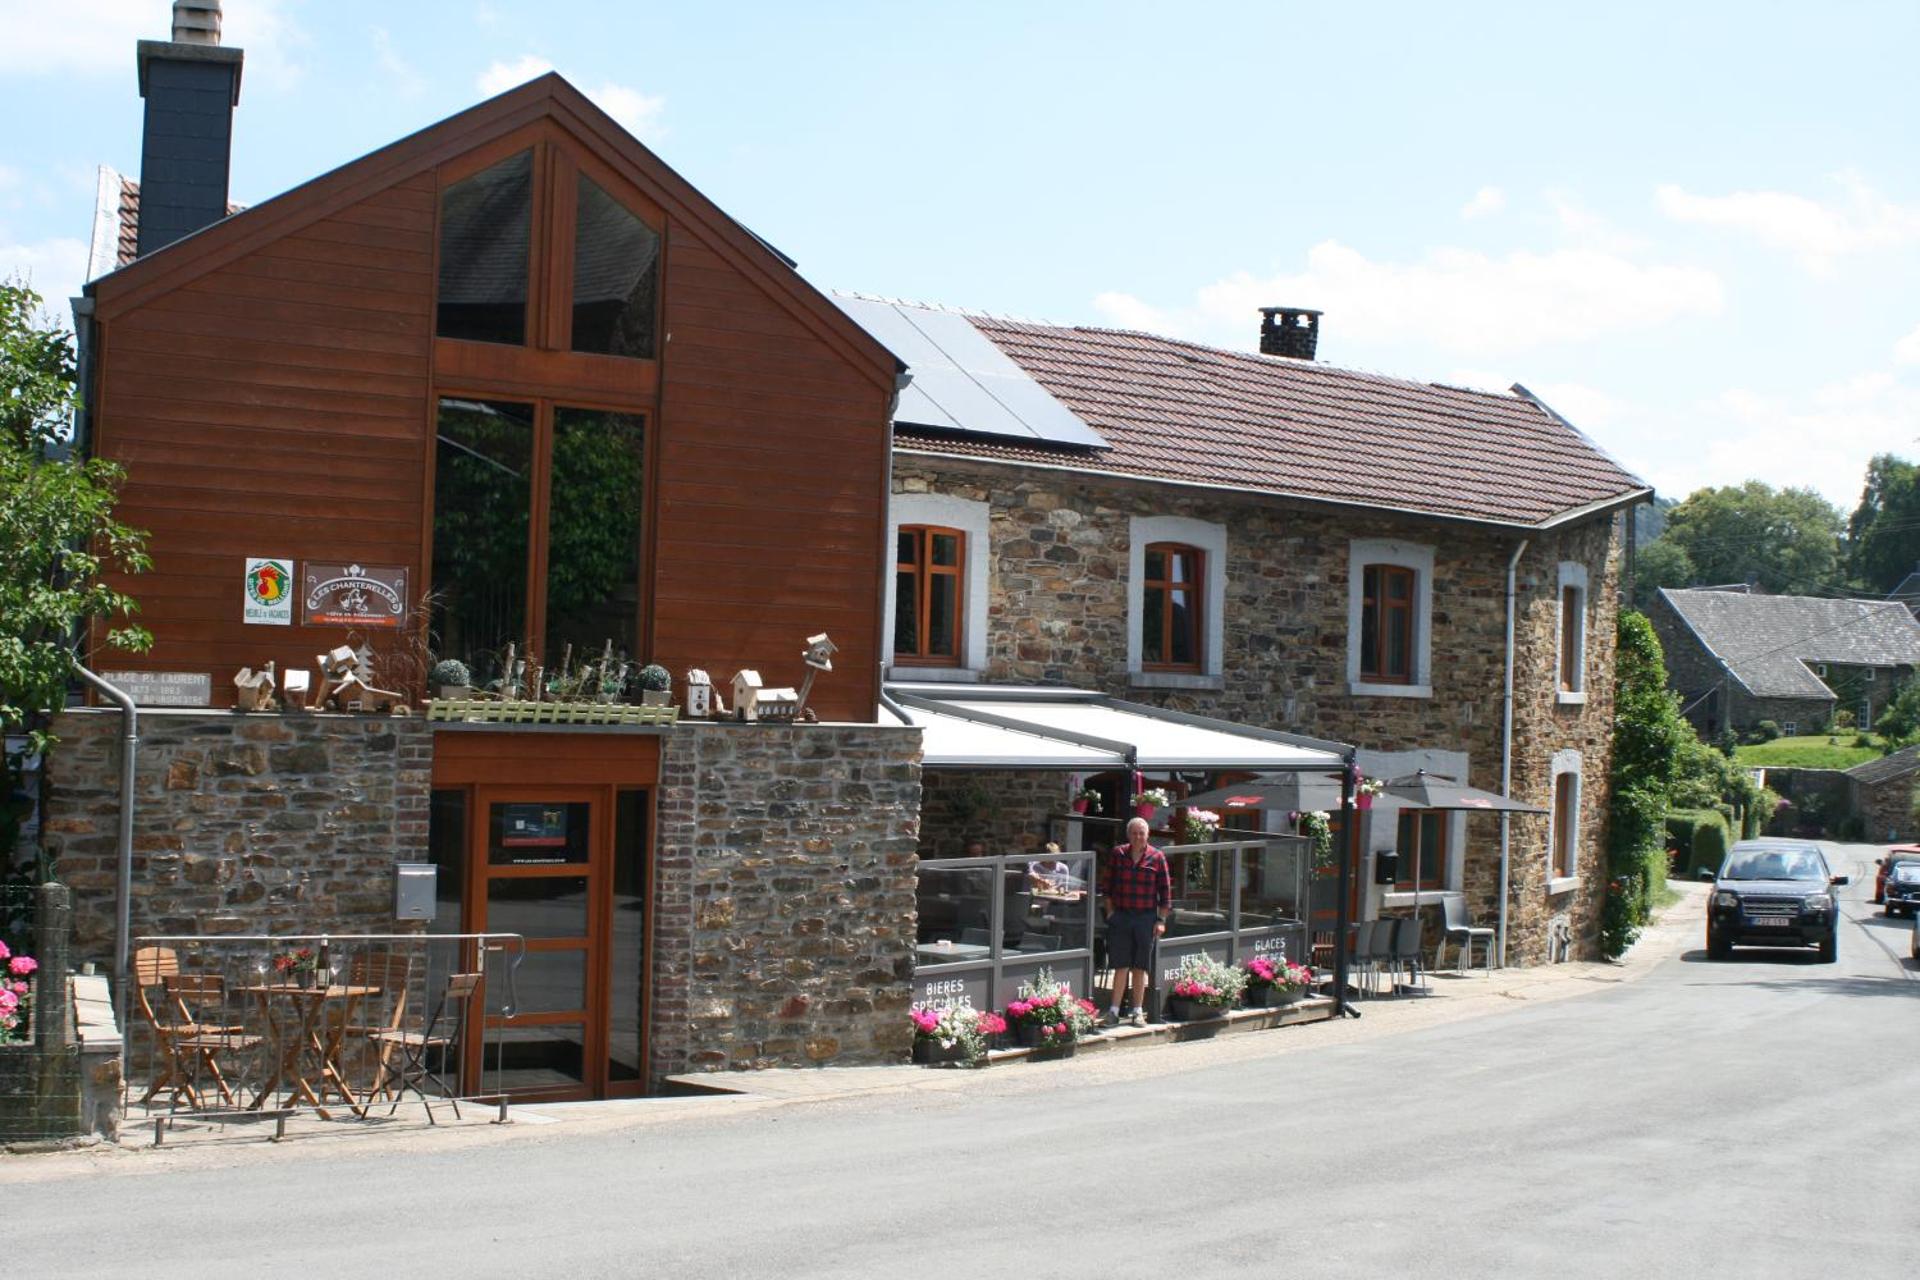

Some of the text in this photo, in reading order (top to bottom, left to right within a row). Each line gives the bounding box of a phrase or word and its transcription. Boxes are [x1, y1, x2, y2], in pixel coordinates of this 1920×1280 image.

[313, 581, 398, 604] LES CHANTERELLES
[161, 673, 206, 685] LAURENT
[1255, 937, 1286, 952] GLACES
[926, 979, 964, 996] BIERES
